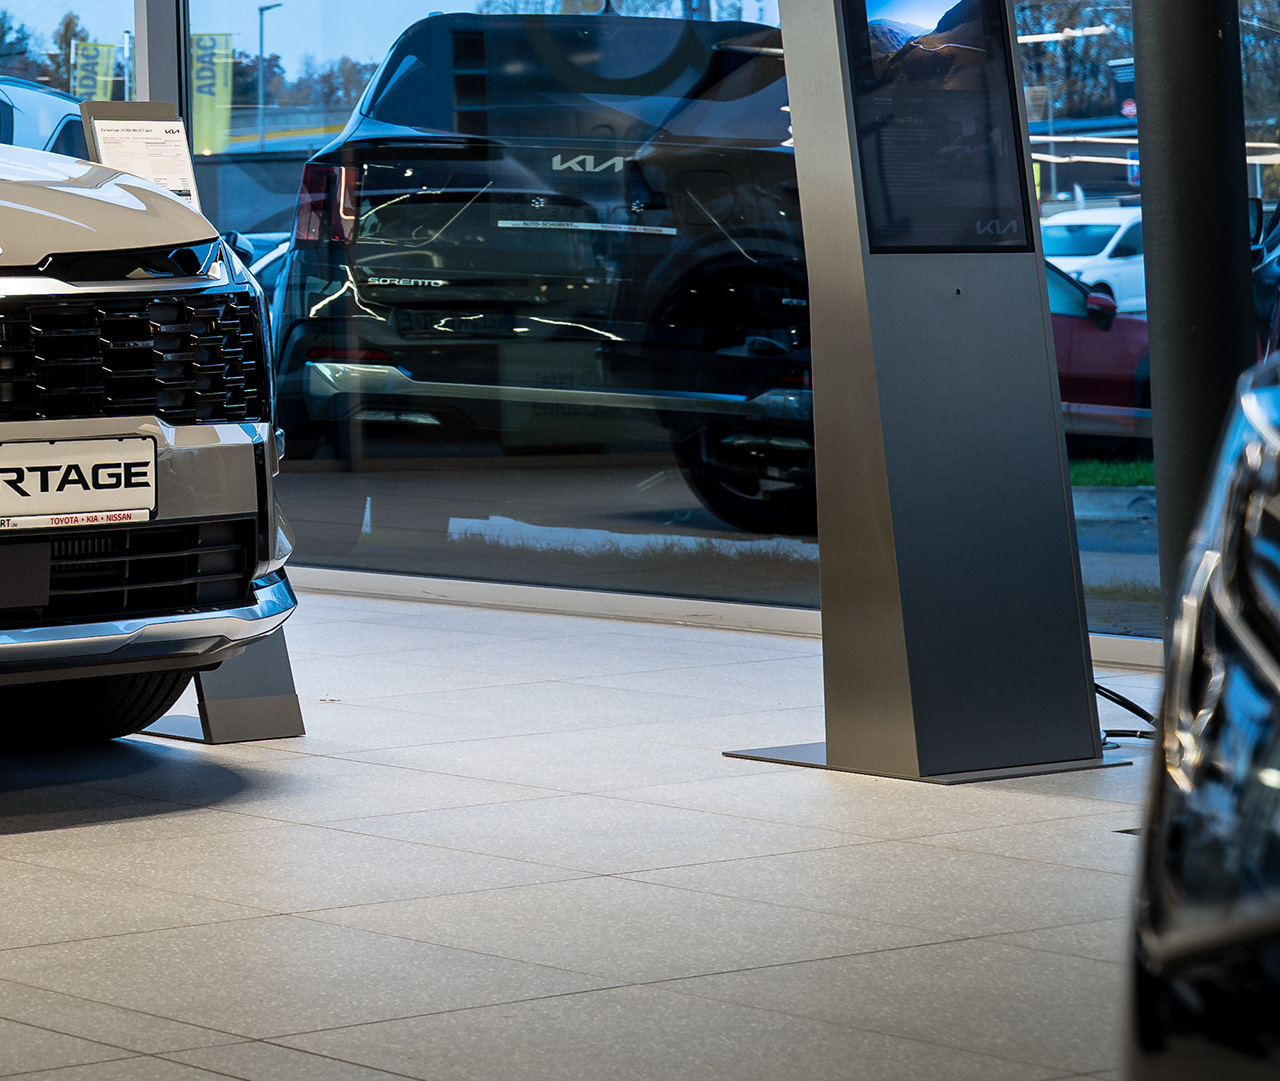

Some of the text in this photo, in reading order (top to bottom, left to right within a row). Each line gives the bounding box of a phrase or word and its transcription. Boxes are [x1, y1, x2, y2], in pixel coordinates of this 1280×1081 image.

[196, 35, 217, 97] ADAC
[552, 154, 624, 172] KIA
[975, 219, 1018, 235] KIA
[368, 276, 444, 288] SORENTO
[50, 514, 79, 525] TOYOTA
[86, 514, 98, 523] KIA
[106, 512, 132, 522] NISSAN
